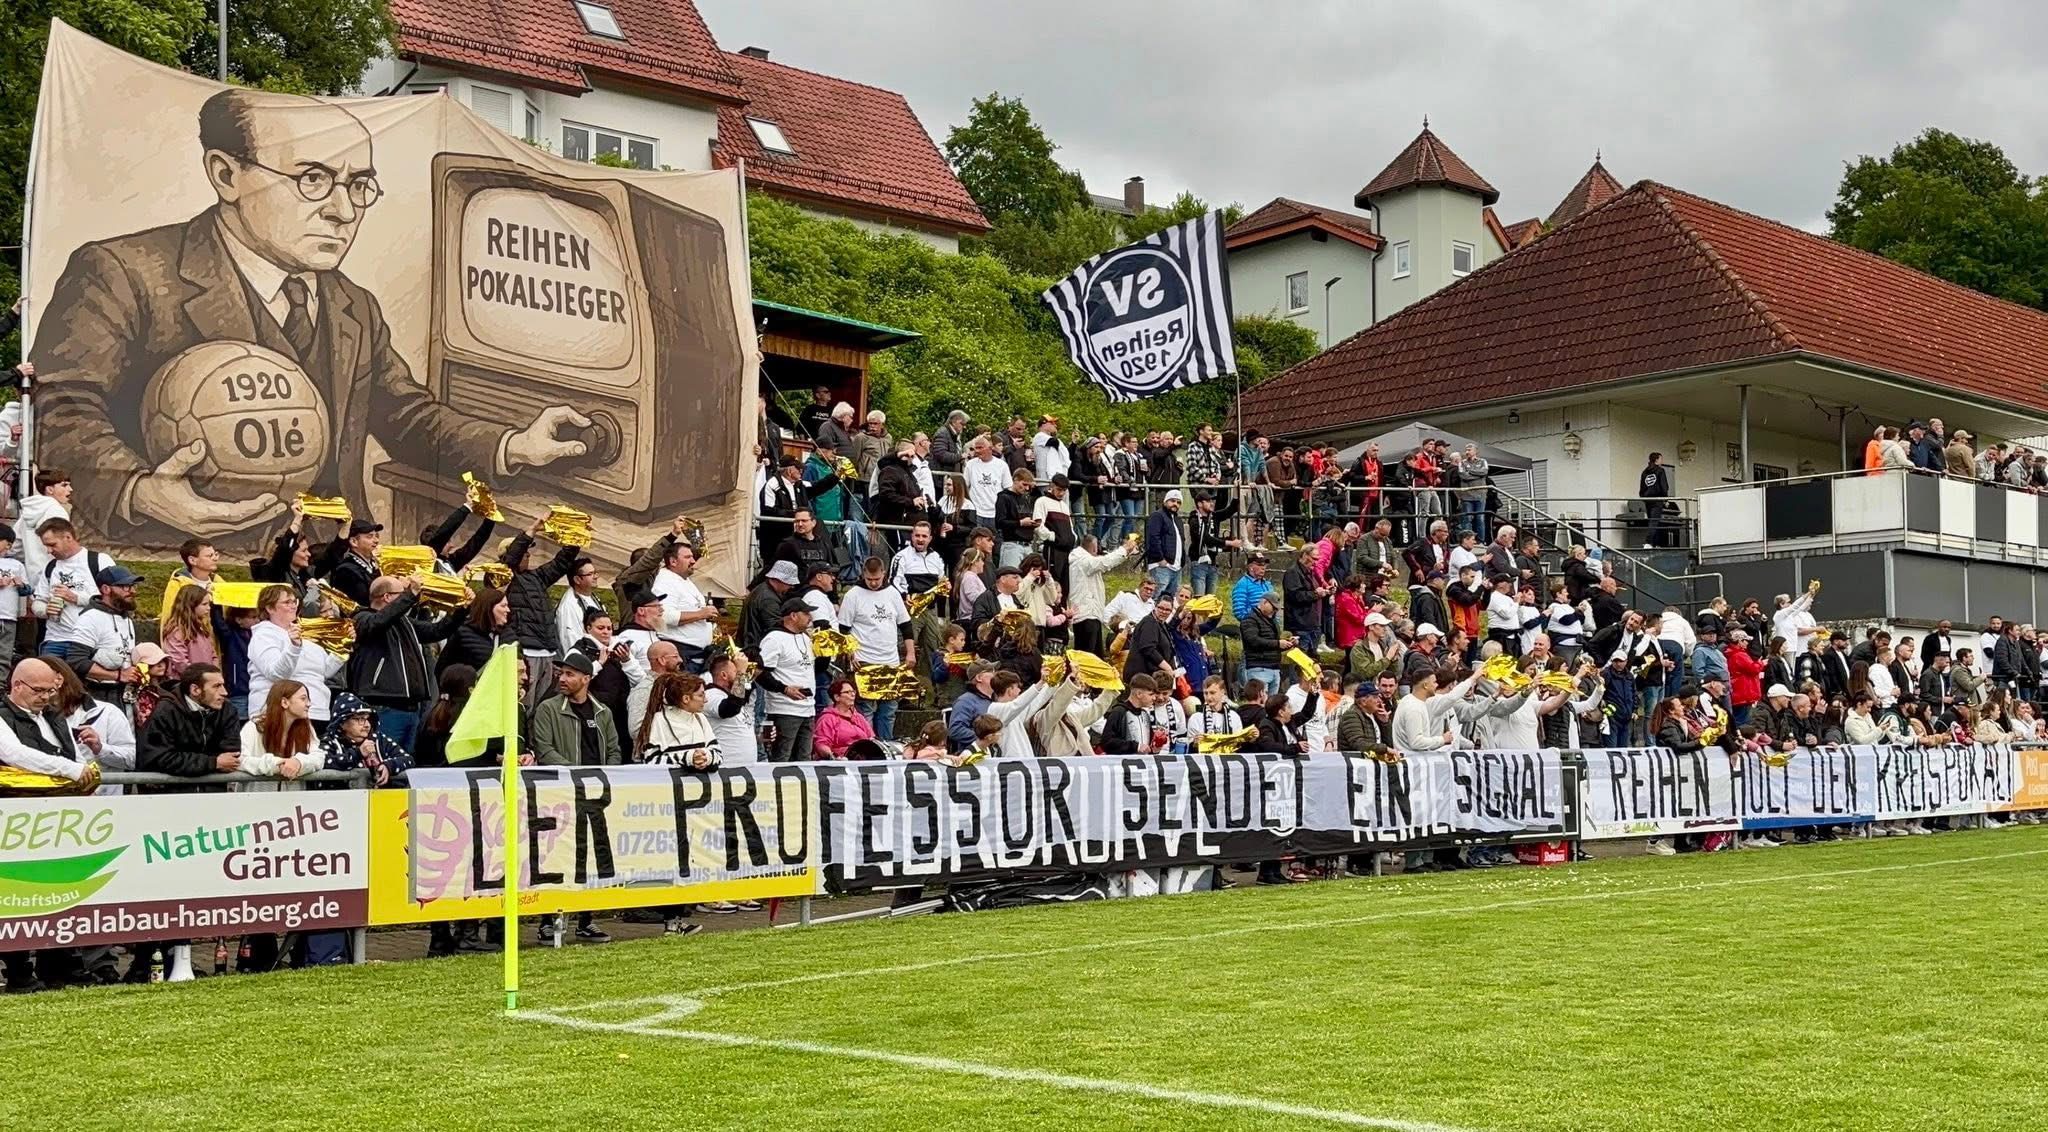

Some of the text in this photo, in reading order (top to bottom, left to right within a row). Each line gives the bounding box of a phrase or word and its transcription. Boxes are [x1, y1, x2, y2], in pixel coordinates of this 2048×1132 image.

[488, 217, 591, 271] REIHEN
[467, 265, 627, 325] POKALSIEGER
[221, 371, 292, 402] 1920
[234, 417, 305, 459] Olé
[1606, 747, 1711, 821] REIHEN
[0, 808, 114, 850] BERG
[143, 805, 339, 864] Naturnahe
[465, 767, 615, 891] DER
[668, 758, 1076, 878] PROFESSOR
[1121, 753, 1311, 832] SENDET
[1341, 751, 1412, 828] EIN
[1450, 751, 1555, 820] SIGNAL
[223, 847, 351, 881] Gärten
[0, 889, 80, 907] chaftsbau
